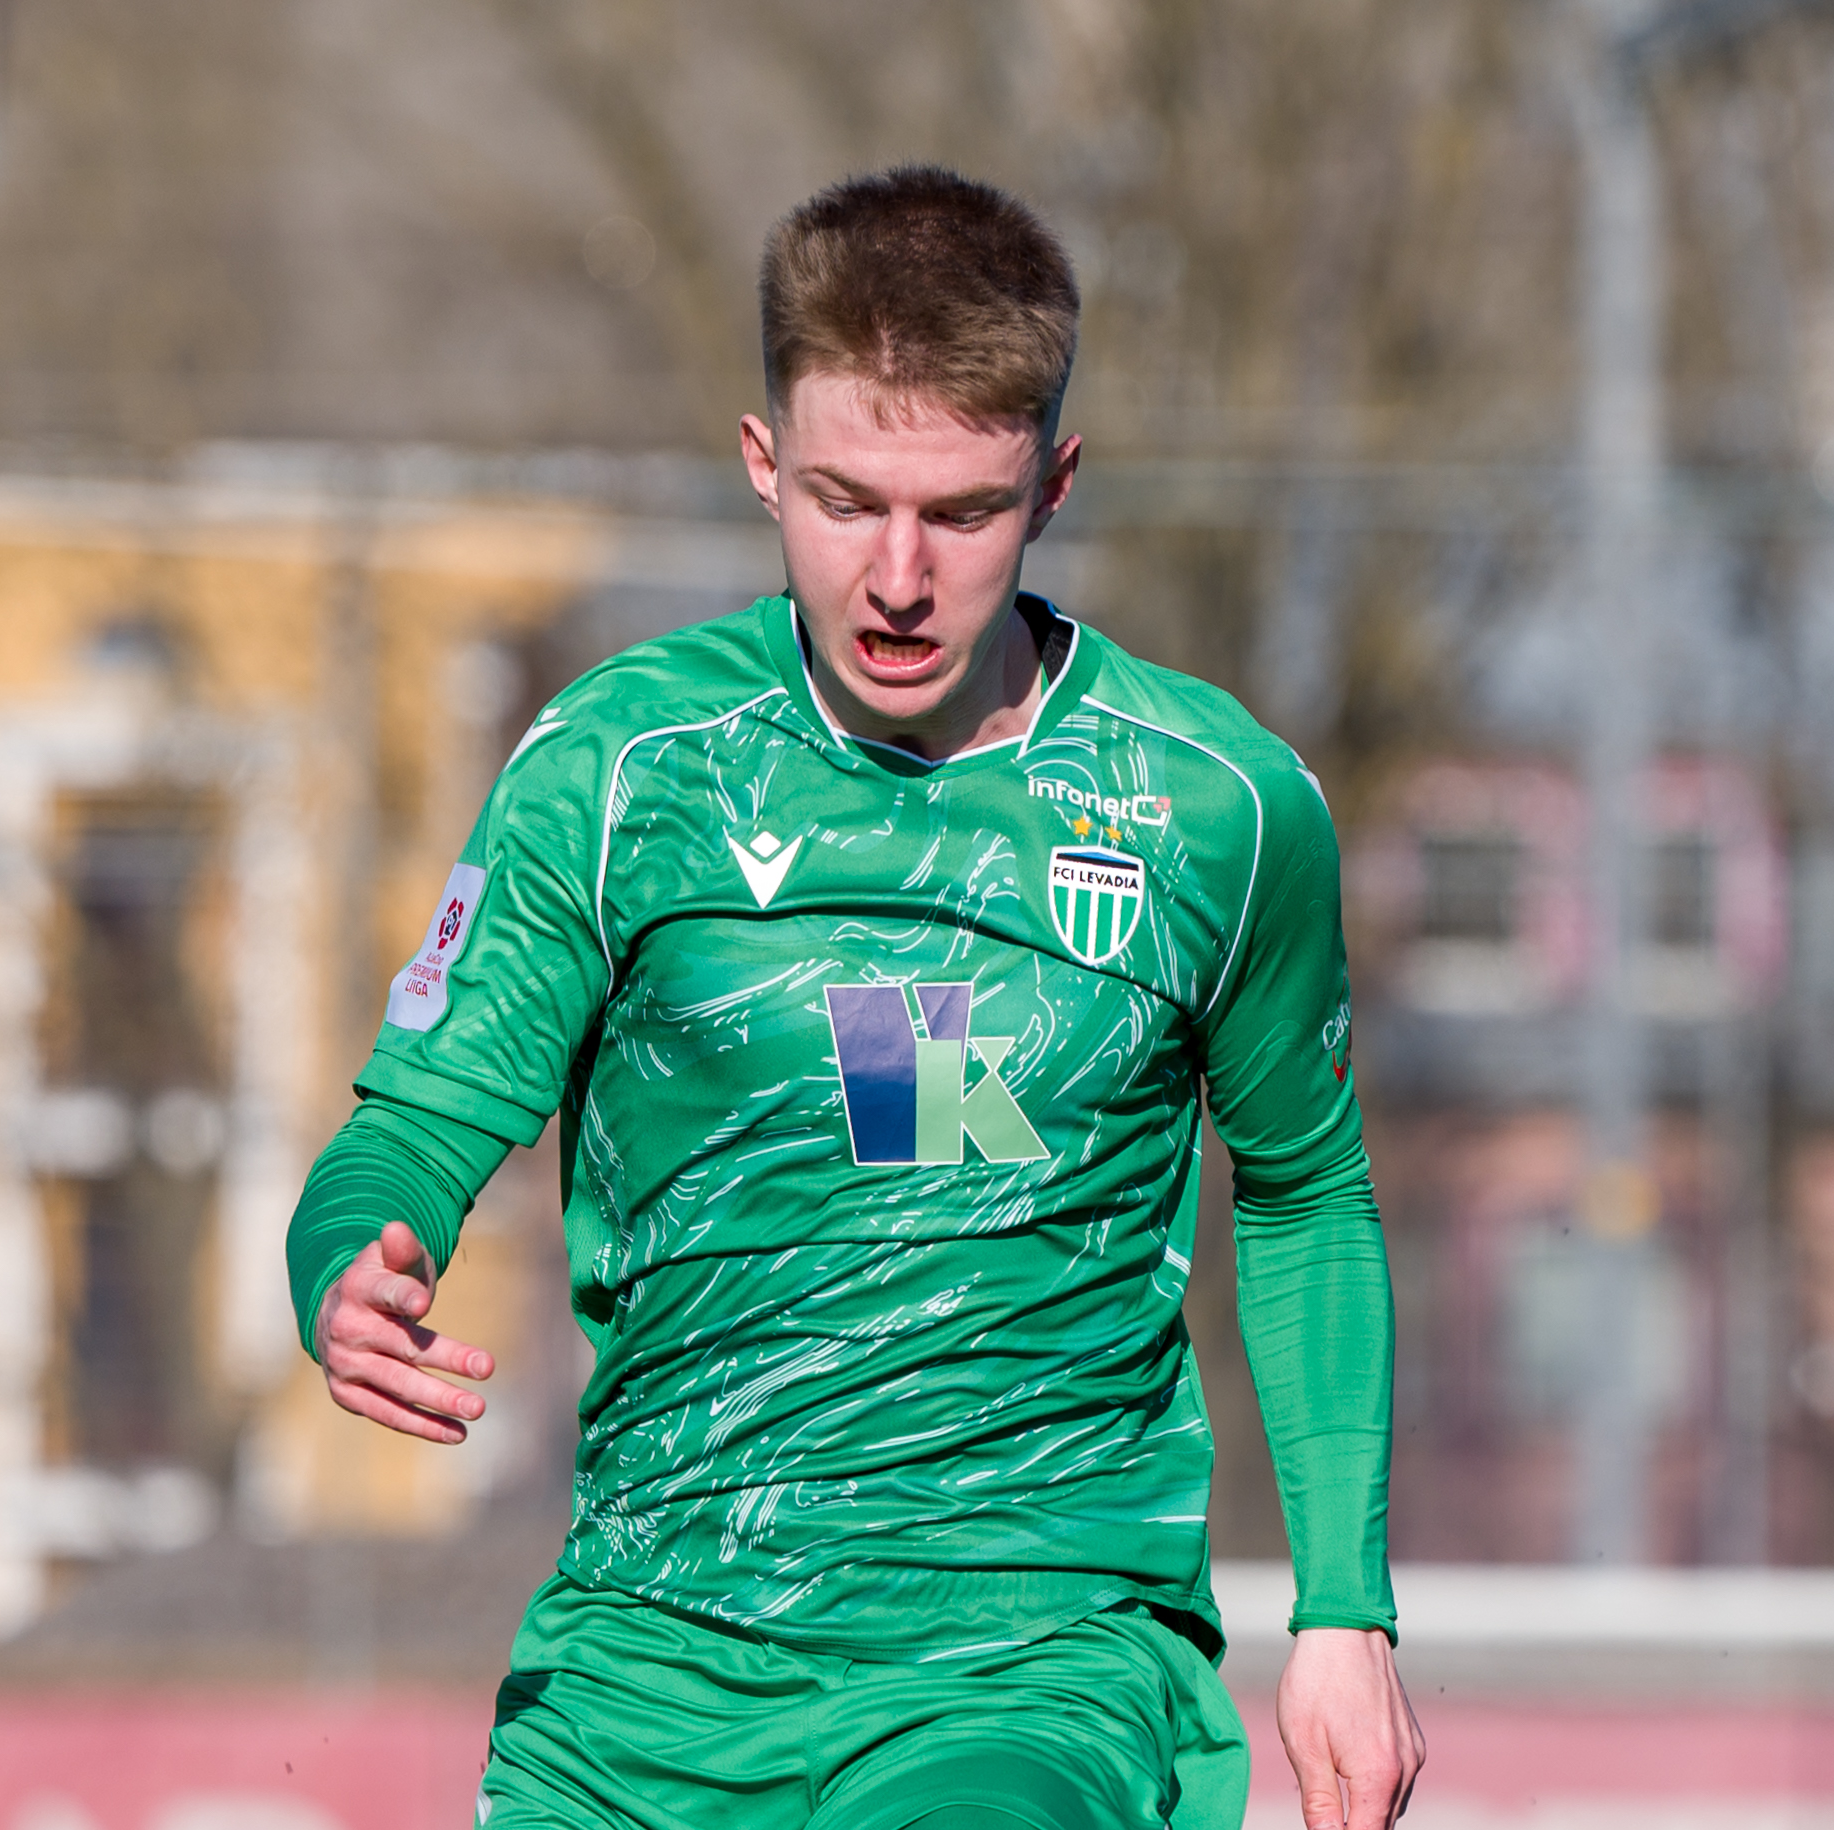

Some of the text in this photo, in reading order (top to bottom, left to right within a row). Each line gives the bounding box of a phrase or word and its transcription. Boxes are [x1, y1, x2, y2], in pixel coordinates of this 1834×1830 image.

[1027, 774, 1132, 820] infonet
[1053, 866, 1139, 890] FCI LEVADIA
